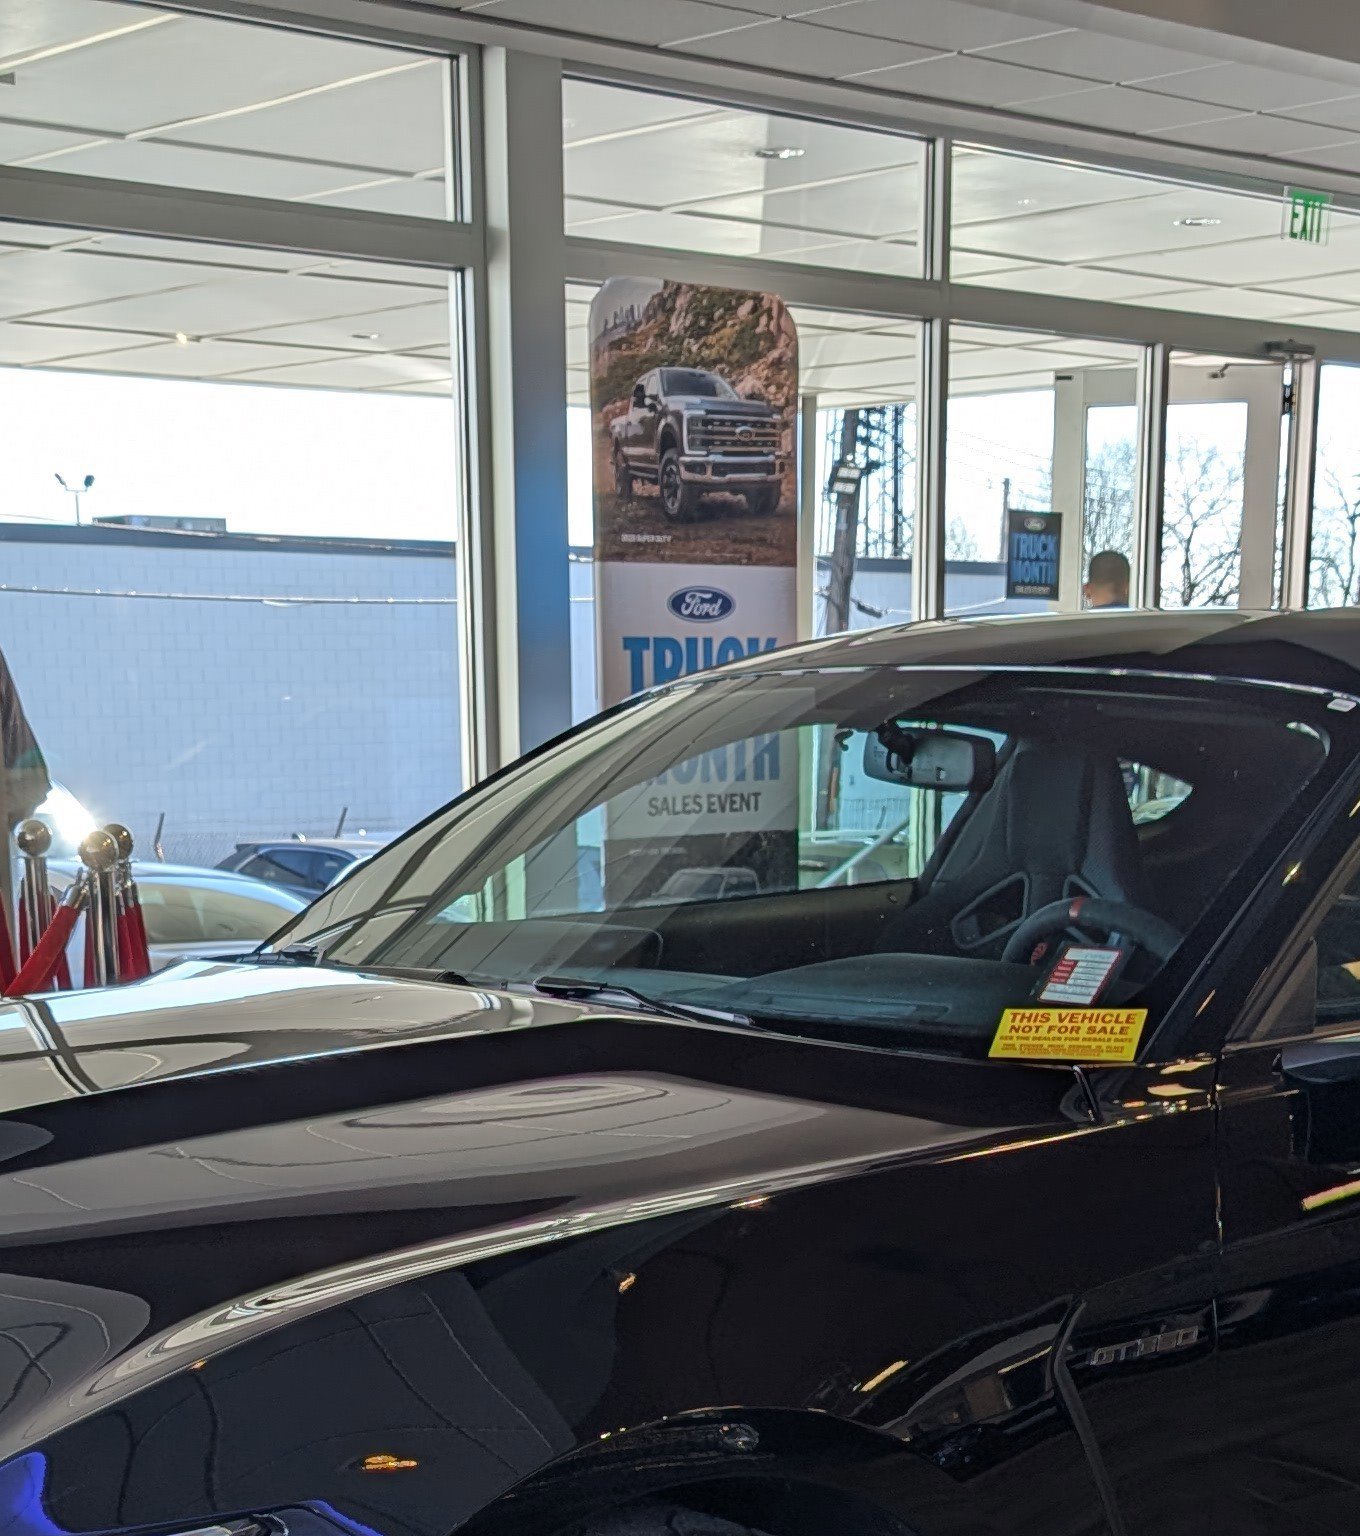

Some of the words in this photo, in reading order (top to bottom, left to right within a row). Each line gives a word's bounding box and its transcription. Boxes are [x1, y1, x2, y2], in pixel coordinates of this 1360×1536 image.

[1290, 193, 1323, 243] EXIT
[1011, 533, 1056, 561] TRUCK
[1011, 561, 1057, 584] MONTH
[680, 591, 723, 617] Ford
[647, 794, 703, 817] SALES
[706, 792, 762, 814] EVENT
[1008, 1025, 1044, 1034] NOT
[1047, 1025, 1082, 1035] FOR
[1085, 1025, 1130, 1036] SALE
[1009, 1012, 1051, 1024] THIS
[1056, 1012, 1138, 1025] VEHICLE
